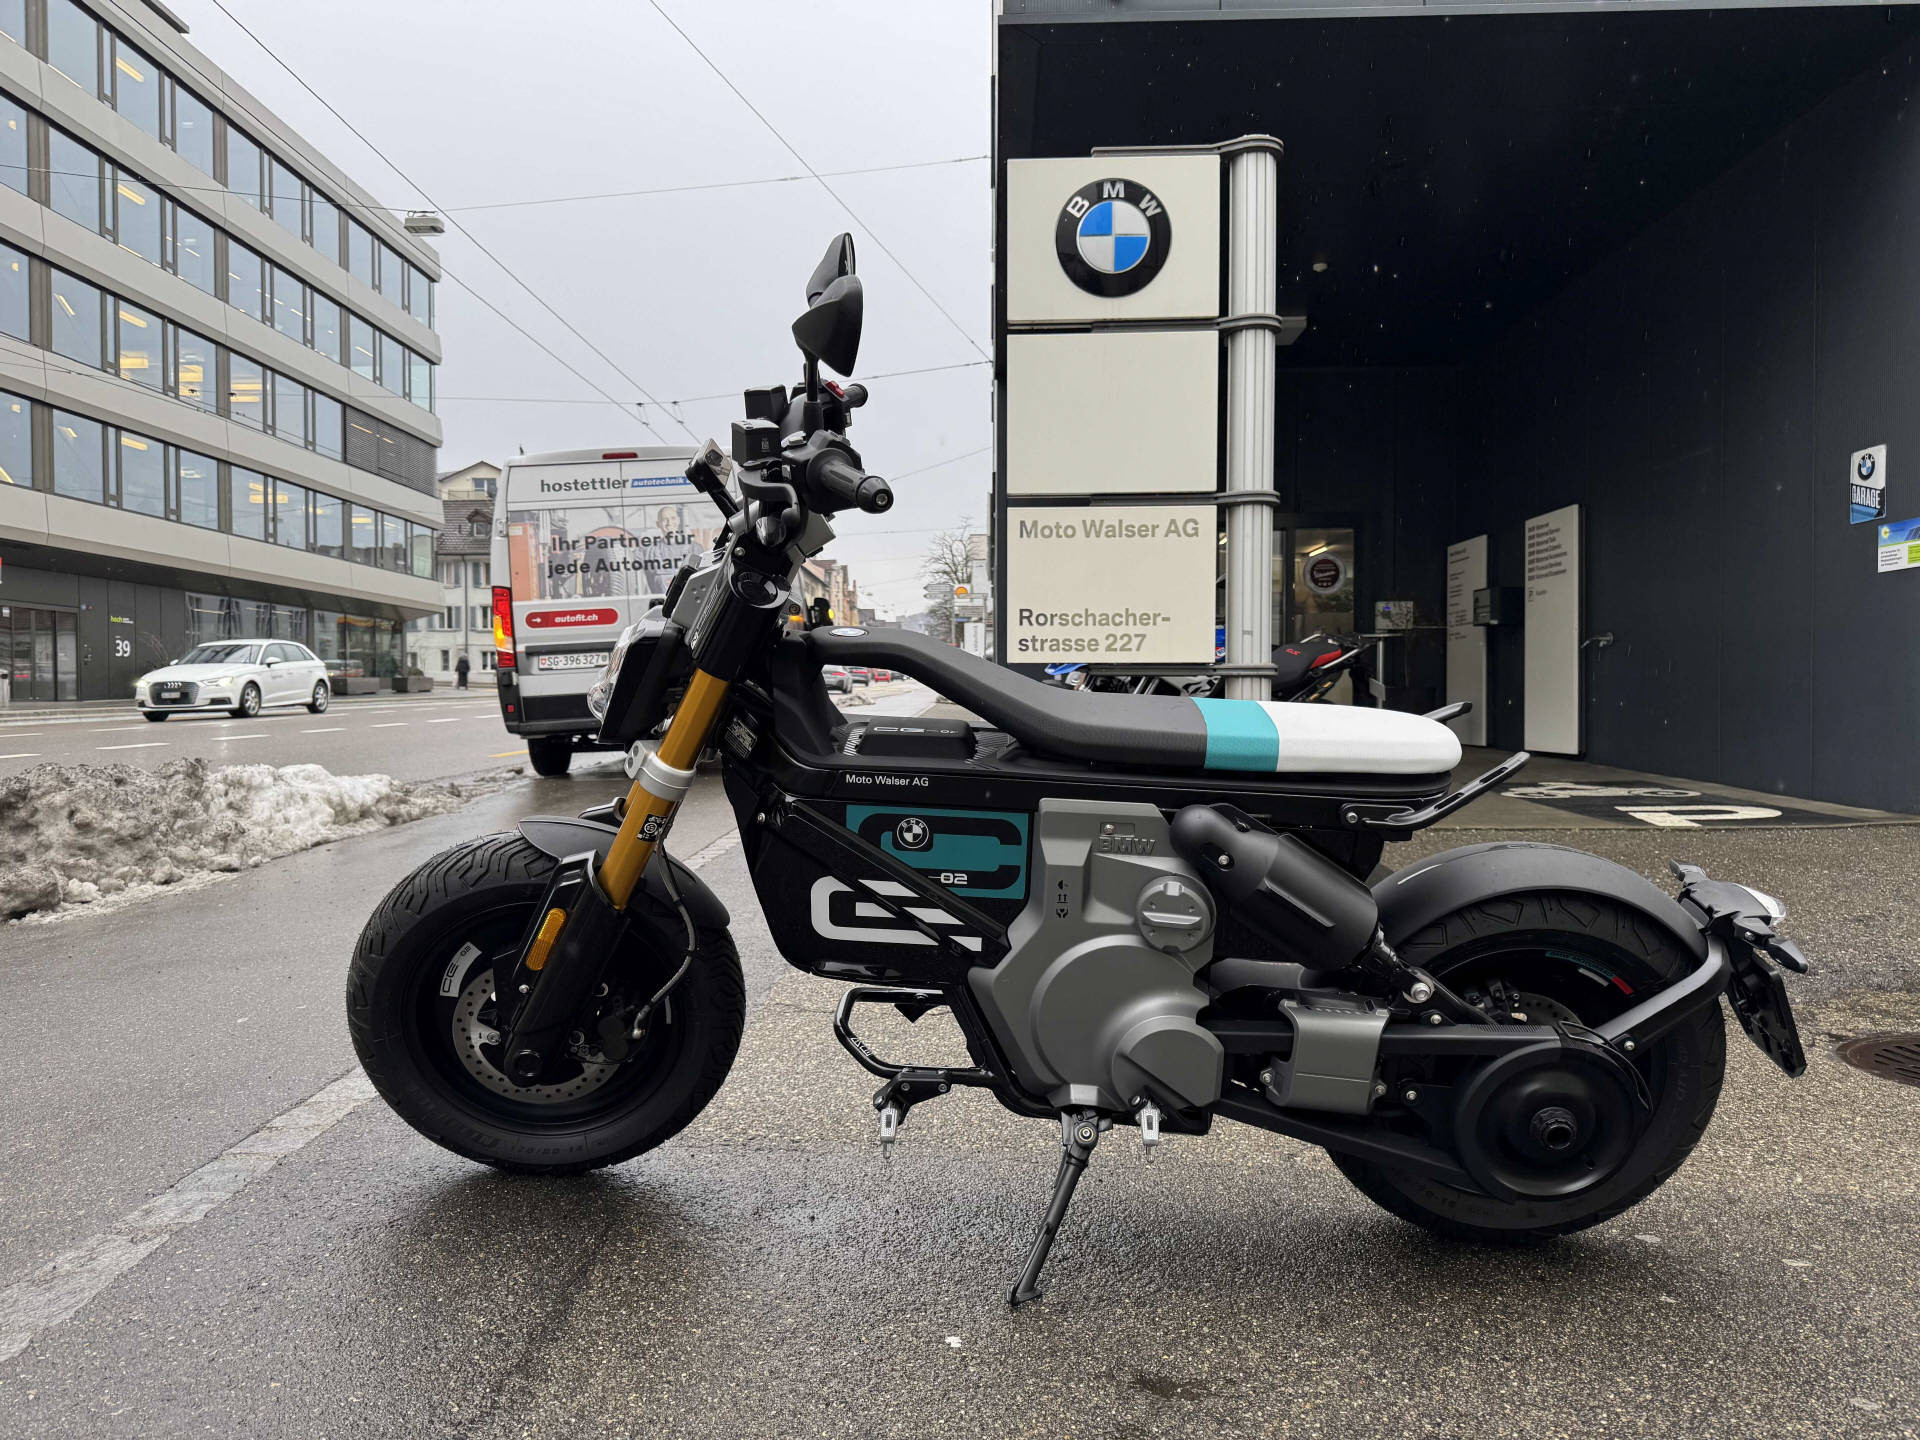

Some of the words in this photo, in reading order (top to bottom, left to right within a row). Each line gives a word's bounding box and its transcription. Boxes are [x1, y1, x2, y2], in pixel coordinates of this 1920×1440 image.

[1066, 181, 1161, 218] BMW
[540, 478, 629, 493] hostettler
[632, 477, 684, 487] autotechnik
[1852, 486, 1881, 508] GARAGE
[1019, 519, 1077, 539] Moto
[1082, 519, 1160, 538] Walser
[1164, 518, 1200, 538] AG
[552, 536, 579, 552] Ihr
[585, 534, 662, 550] Partner
[665, 530, 695, 546] für
[548, 558, 591, 579] jede
[554, 613, 599, 623] autofit.ch
[1018, 608, 1171, 627] Rorschacher-
[115, 639, 131, 657] 39
[1018, 635, 1099, 652] strasse
[1104, 633, 1147, 652] 227
[846, 774, 873, 784] Moto
[875, 775, 910, 786] Walser
[912, 777, 929, 787] AG
[940, 872, 968, 885] 02
